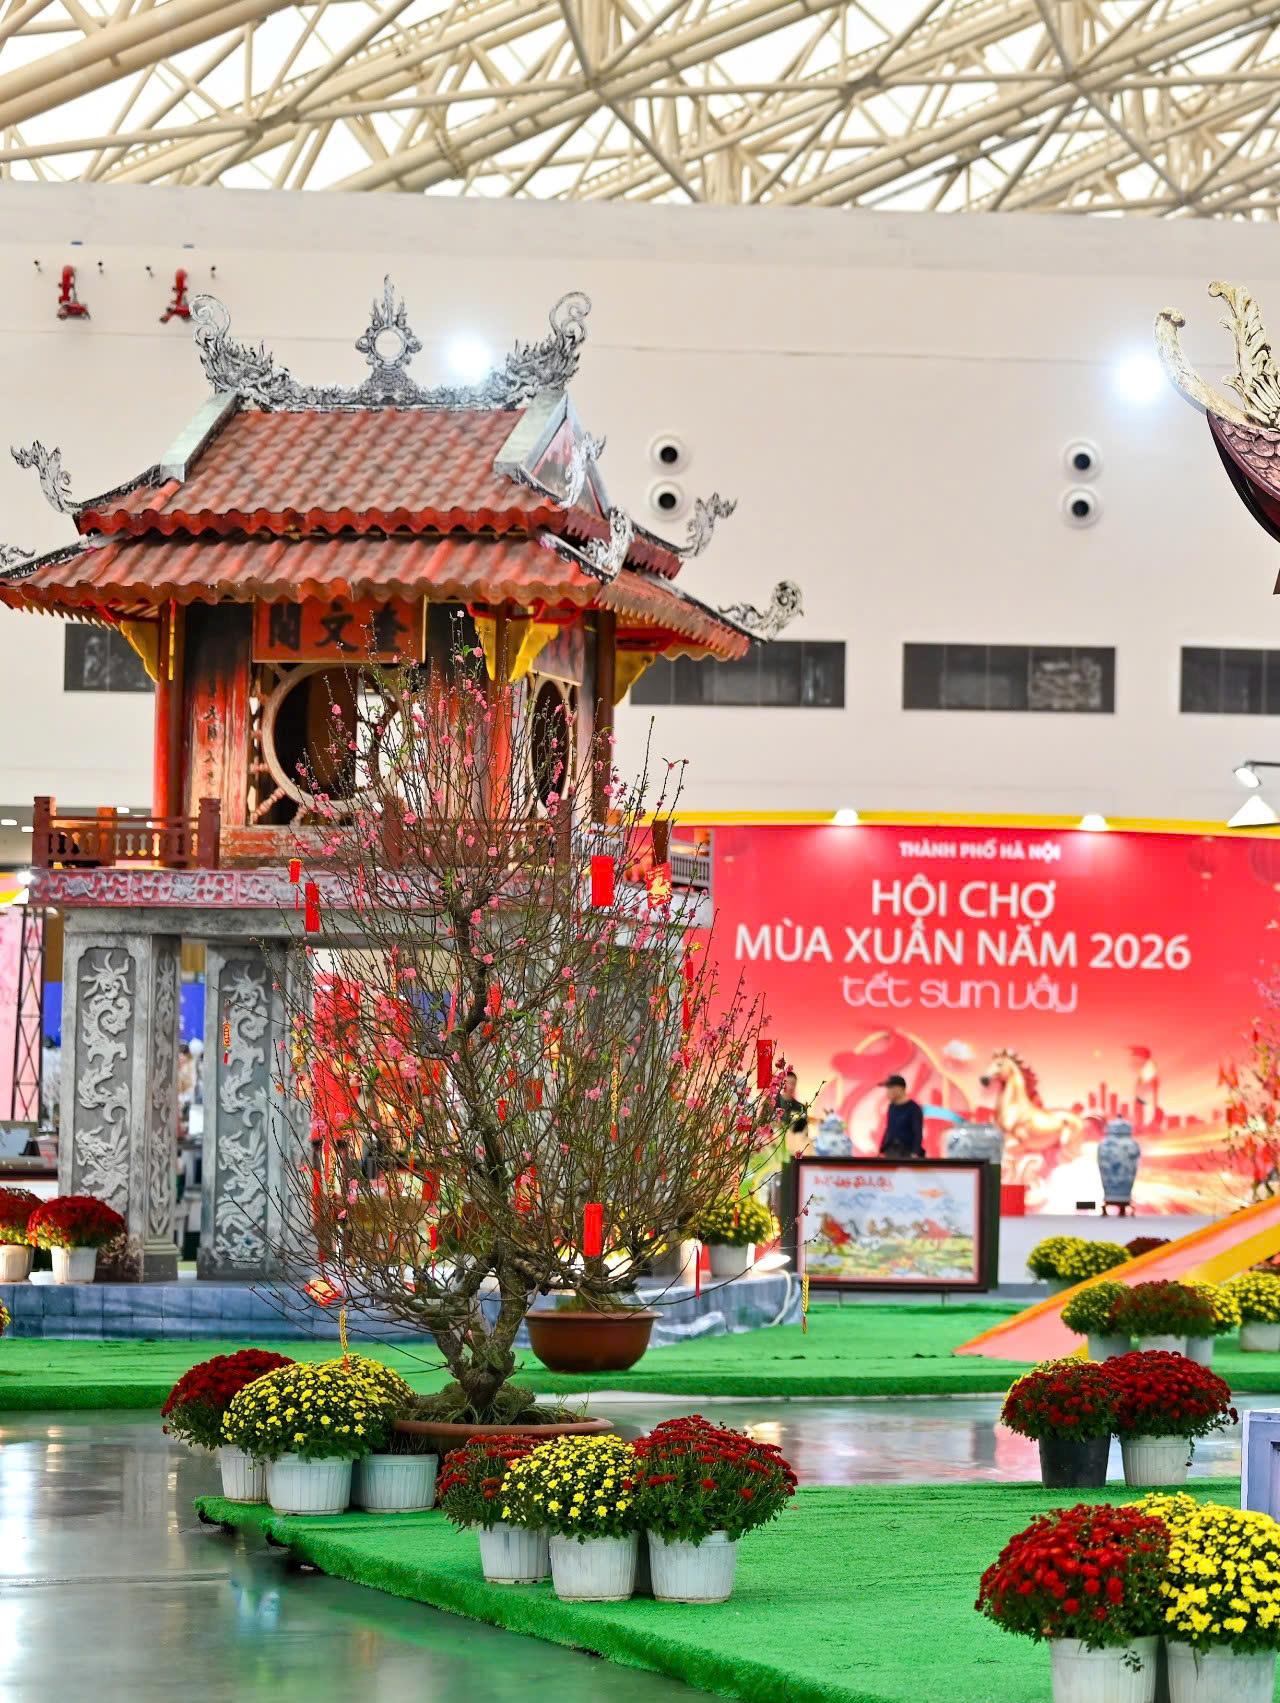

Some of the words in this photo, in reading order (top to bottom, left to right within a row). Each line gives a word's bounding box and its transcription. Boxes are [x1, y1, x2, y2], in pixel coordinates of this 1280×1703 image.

[900, 838, 956, 858] THÀNH
[960, 839, 997, 859] PHỐ
[1001, 840, 1025, 860] HÀ
[1029, 841, 1061, 863] NỘI
[872, 873, 947, 920] HỘI
[959, 880, 1056, 927] CHỢ
[735, 917, 833, 962] MÙA
[844, 918, 964, 965] XUÂN
[976, 924, 1078, 967] NĂM
[1089, 933, 1191, 970] 2026
